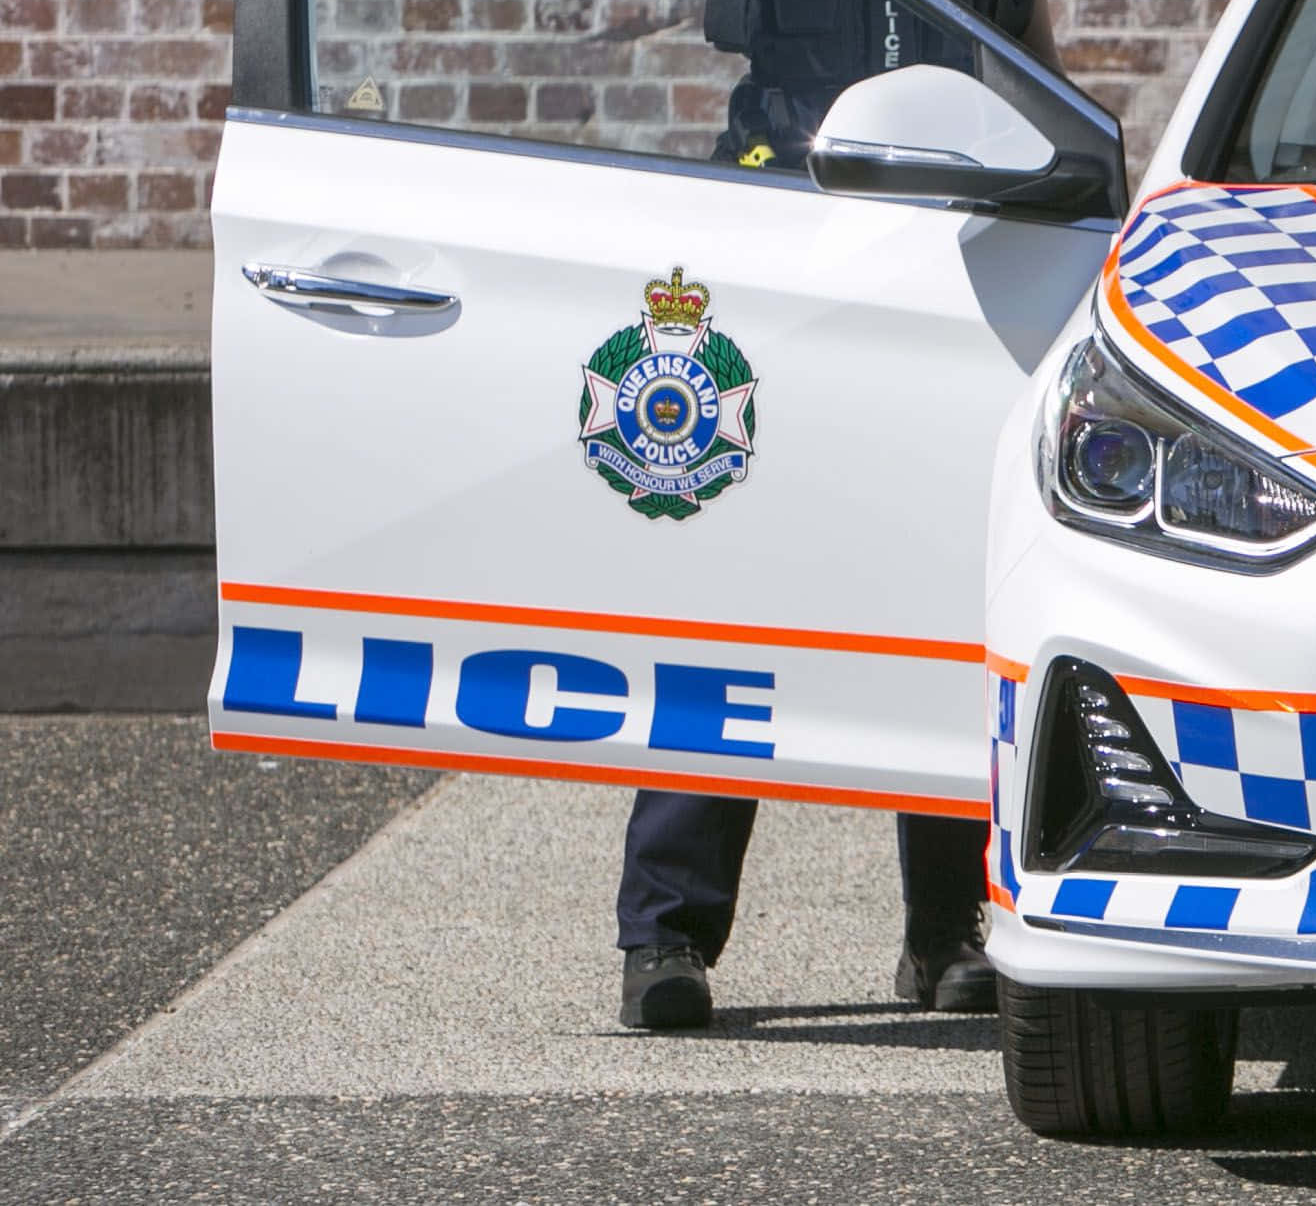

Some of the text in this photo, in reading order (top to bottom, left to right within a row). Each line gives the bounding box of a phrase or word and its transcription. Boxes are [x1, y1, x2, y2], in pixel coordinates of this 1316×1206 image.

[618, 356, 718, 419] QUEENSLAND
[599, 446, 734, 491] WITH HONOUR WE SERVE
[632, 433, 700, 464] POLICE
[222, 625, 776, 761] LICE
